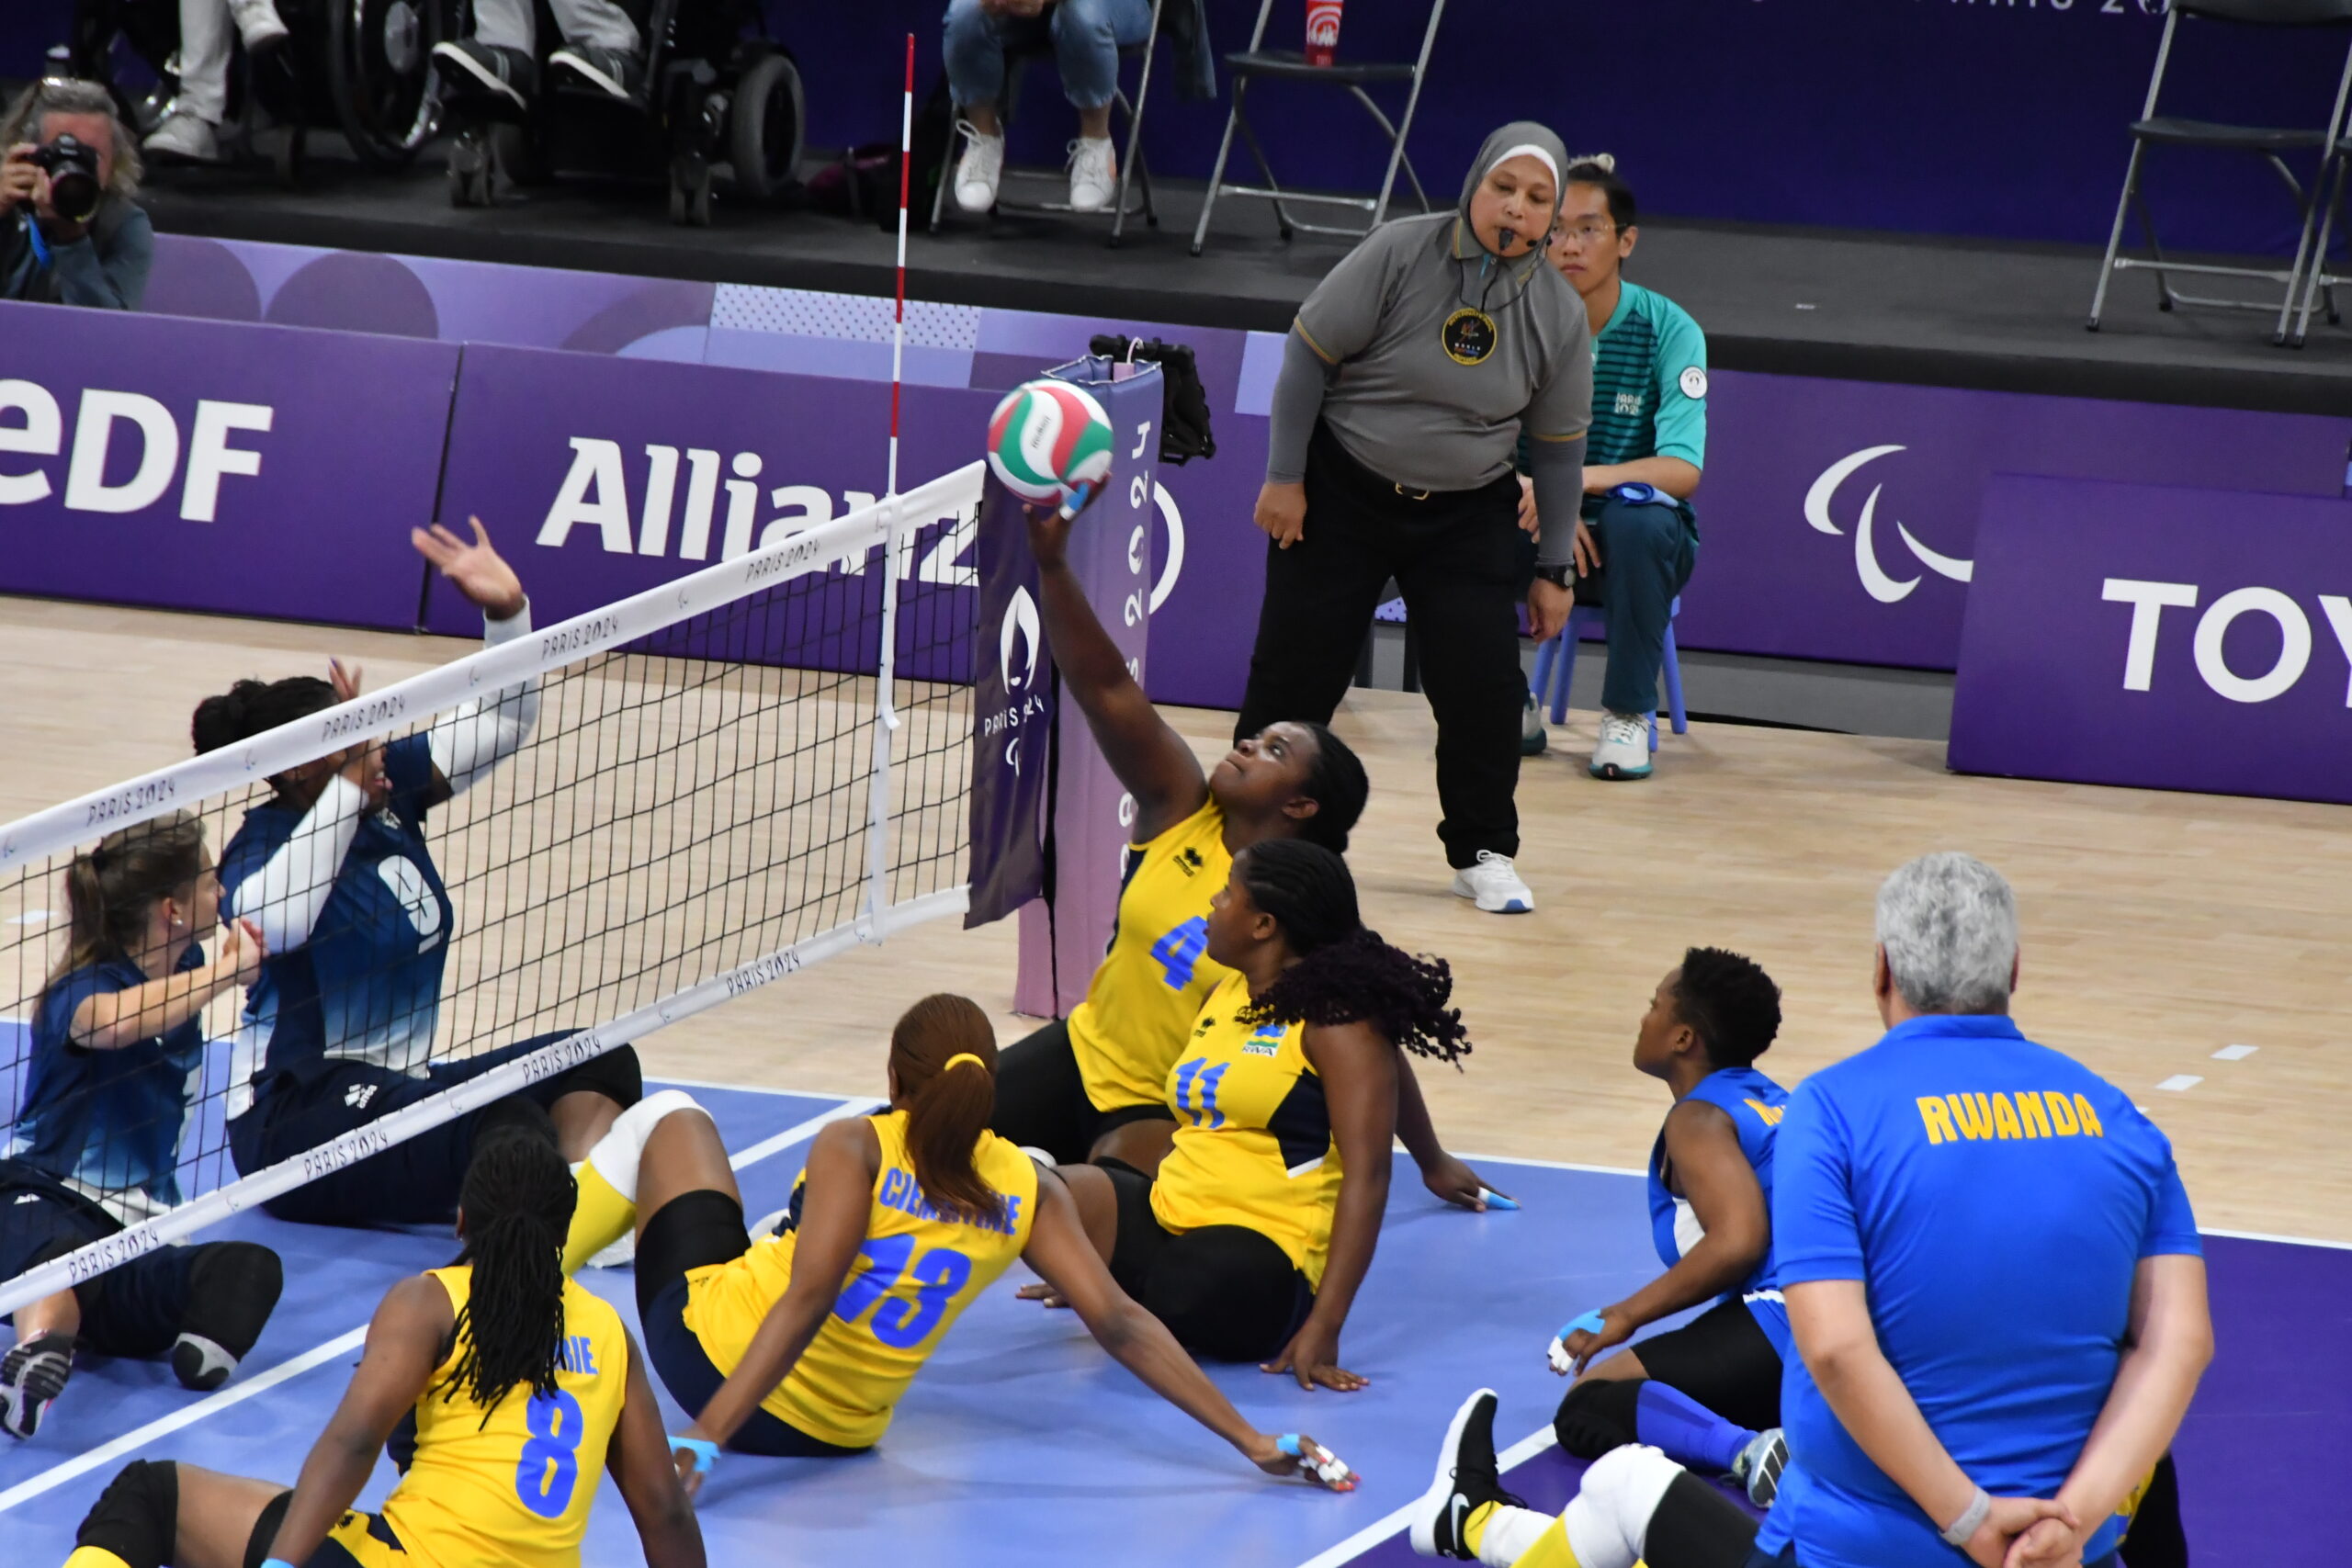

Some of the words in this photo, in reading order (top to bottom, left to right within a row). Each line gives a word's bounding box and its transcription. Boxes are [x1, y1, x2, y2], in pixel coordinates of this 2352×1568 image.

[744, 552, 784, 582] PARIS
[785, 538, 820, 568] 2024
[541, 629, 581, 660] PARIS
[583, 614, 619, 645] 2024
[322, 708, 365, 742] PARIS
[368, 694, 405, 726] 2024
[86, 792, 131, 828] PARIS
[137, 777, 175, 809] 2024
[726, 964, 766, 998] PARIS
[768, 950, 801, 981] 2024
[1150, 915, 1209, 991] 4
[522, 1050, 564, 1084] PARIS
[566, 1034, 602, 1066] 2024
[1176, 1056, 1230, 1129] 11
[1916, 1091, 2104, 1145] RWANDA
[303, 1149, 346, 1181] PARIS
[349, 1129, 389, 1162] 2024
[68, 1245, 116, 1281] PARIS
[118, 1225, 160, 1263] 2024
[831, 1233, 972, 1349] 13
[515, 1388, 583, 1518] 8
